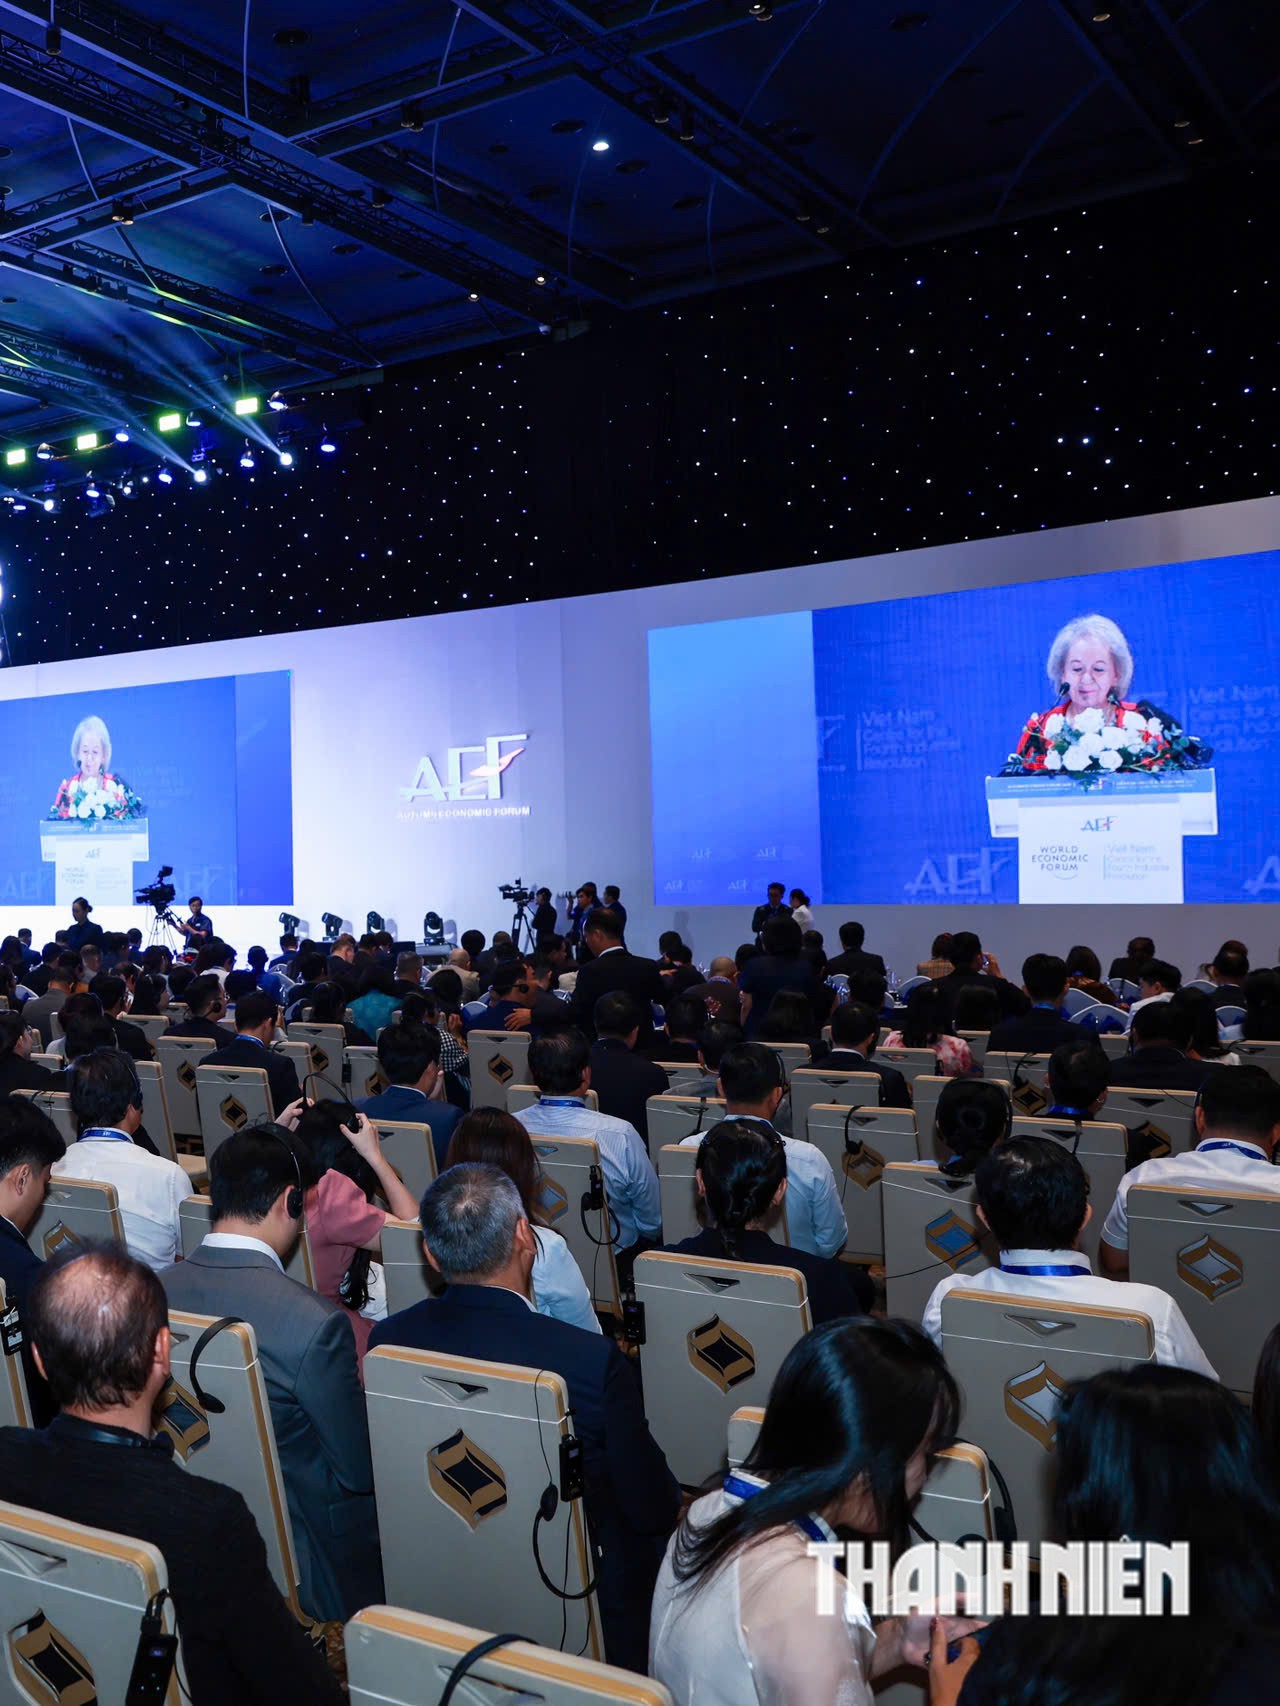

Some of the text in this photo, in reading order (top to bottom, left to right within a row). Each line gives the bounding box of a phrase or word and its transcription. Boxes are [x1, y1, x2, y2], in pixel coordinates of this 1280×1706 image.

[399, 733, 528, 802] AEF
[1080, 815, 1118, 831] AEF
[1040, 845, 1078, 854] WORLD
[1032, 854, 1088, 863] ECONOMIC
[1040, 863, 1078, 871] FORUM
